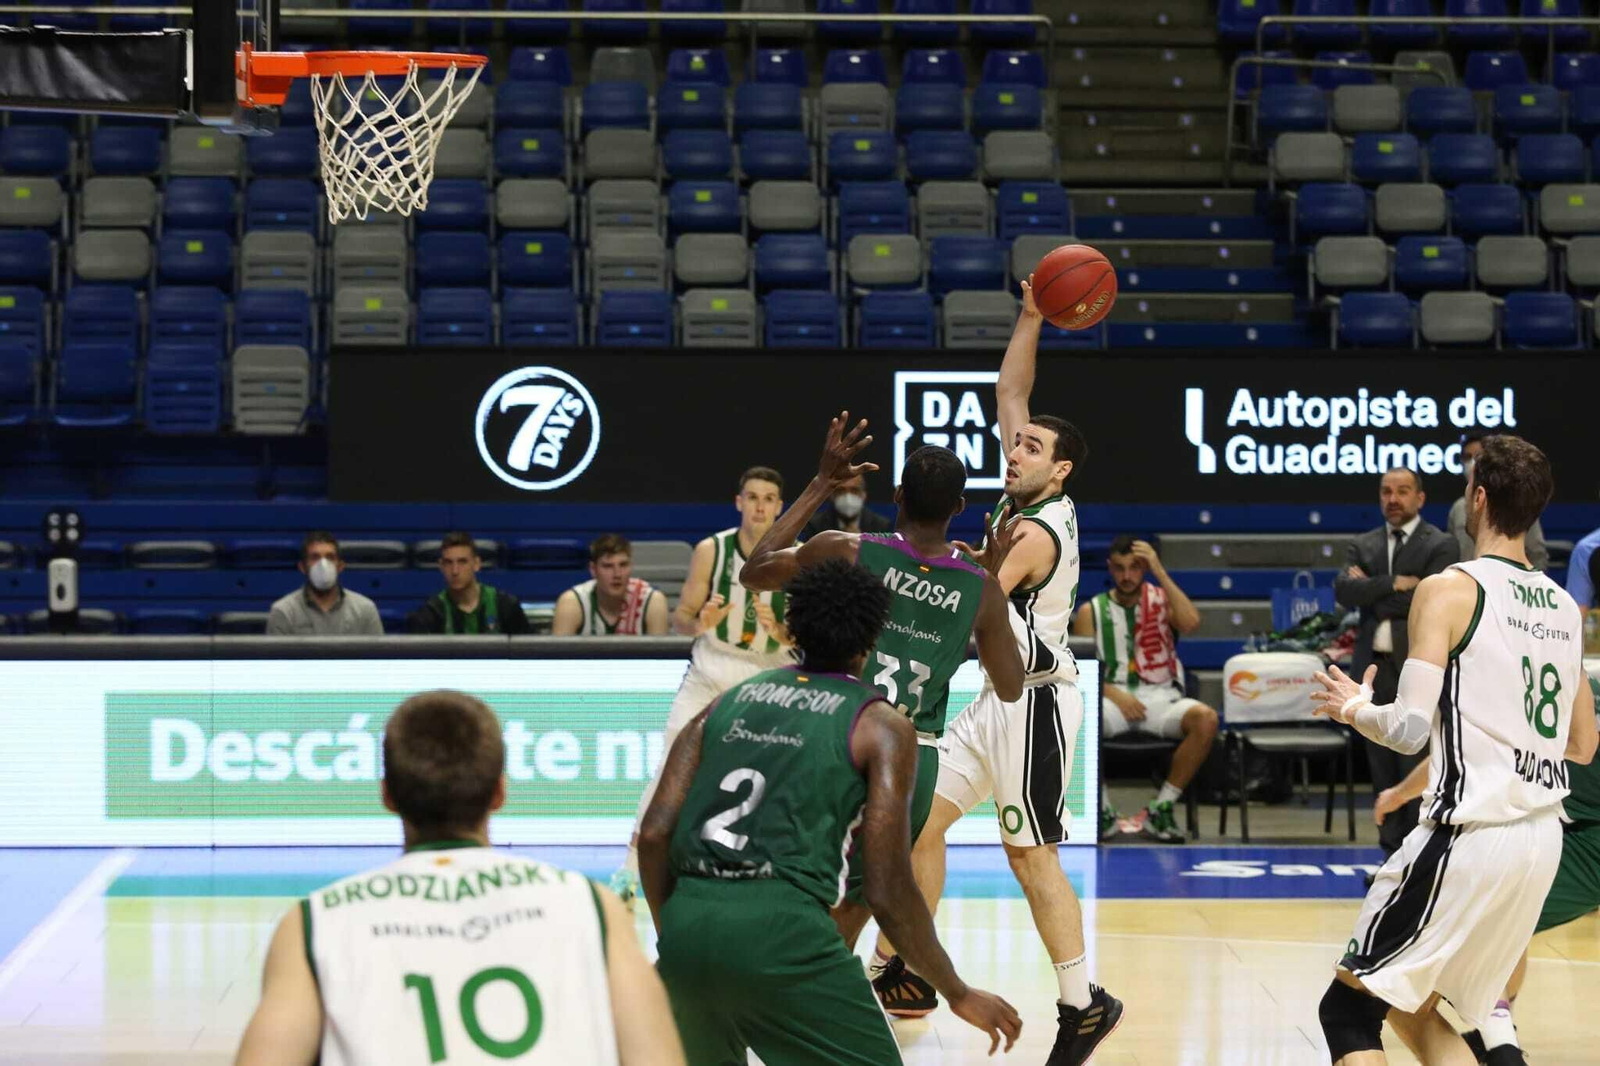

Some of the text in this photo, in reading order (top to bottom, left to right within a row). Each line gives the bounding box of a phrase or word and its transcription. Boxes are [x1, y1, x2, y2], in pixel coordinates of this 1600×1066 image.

[500, 385, 566, 471] 7
[532, 392, 584, 469] DAYS
[1227, 387, 1517, 435] Autopista del
[883, 567, 962, 614] NZOSA
[1546, 628, 1570, 642] FUTUR
[734, 682, 847, 715] THOMPSON
[874, 651, 931, 716] 33
[1522, 655, 1562, 739] 88
[700, 767, 767, 851] 2
[323, 862, 569, 909] BRODZIANSKY
[1179, 860, 1381, 878] San
[403, 965, 544, 1064] 10
